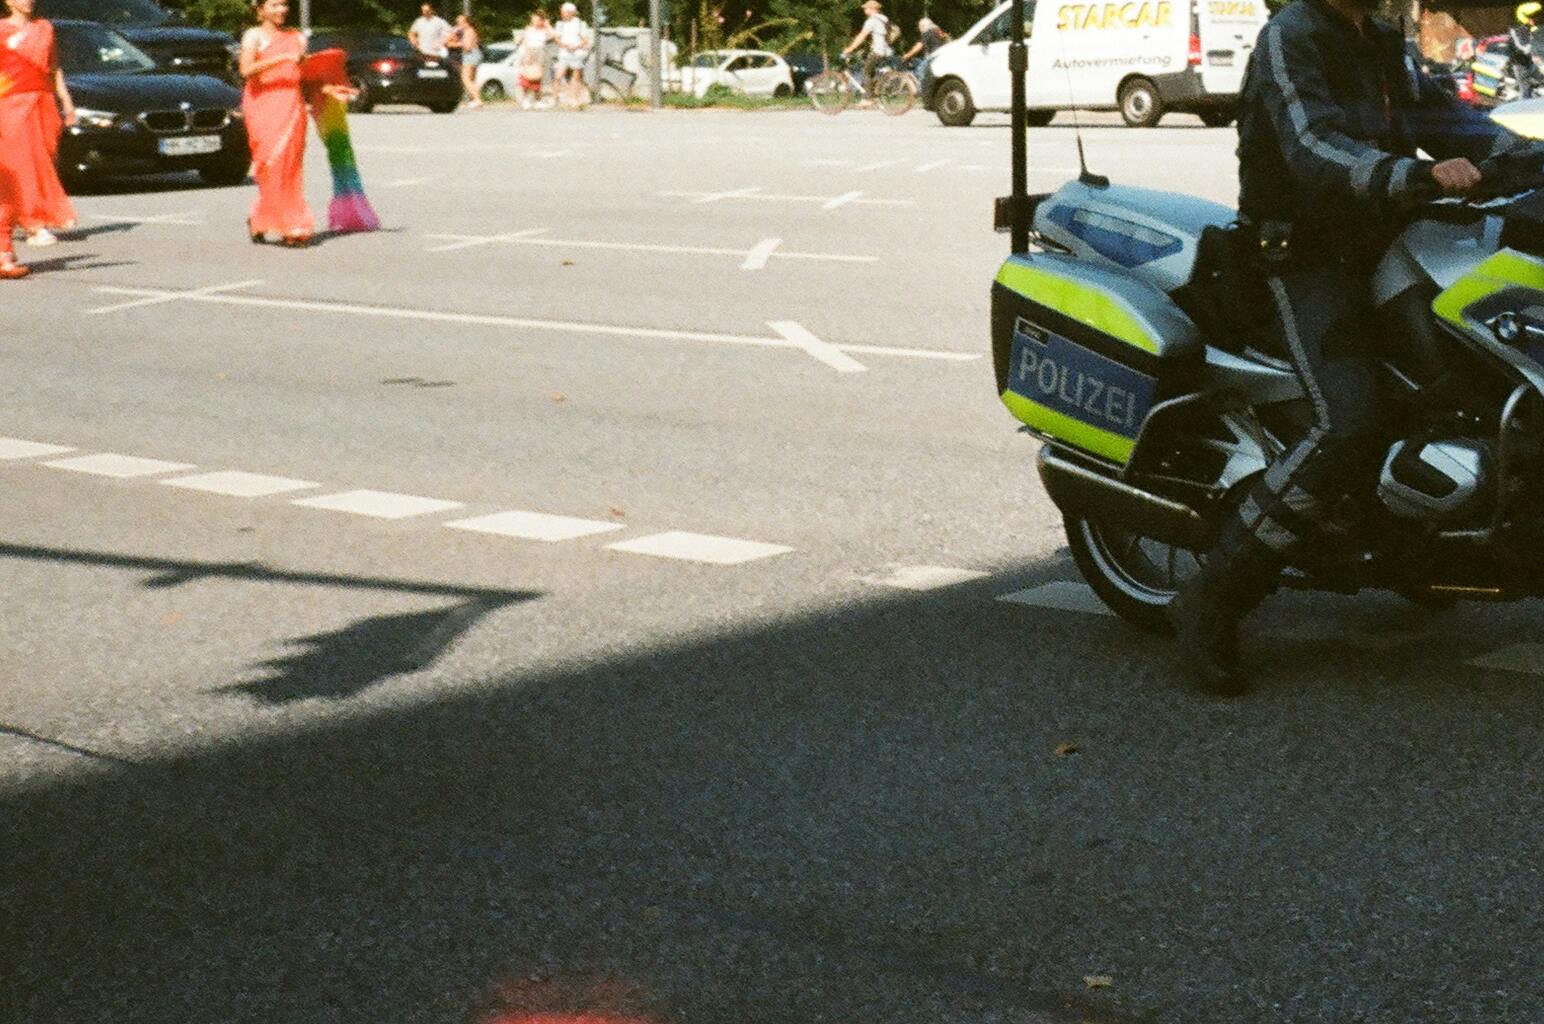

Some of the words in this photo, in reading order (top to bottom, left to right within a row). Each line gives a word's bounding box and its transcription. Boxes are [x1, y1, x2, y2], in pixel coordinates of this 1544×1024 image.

[1057, 1, 1171, 30] STARCAR
[1053, 54, 1171, 69] Autovermietung
[1019, 347, 1135, 426] POLIZEI
